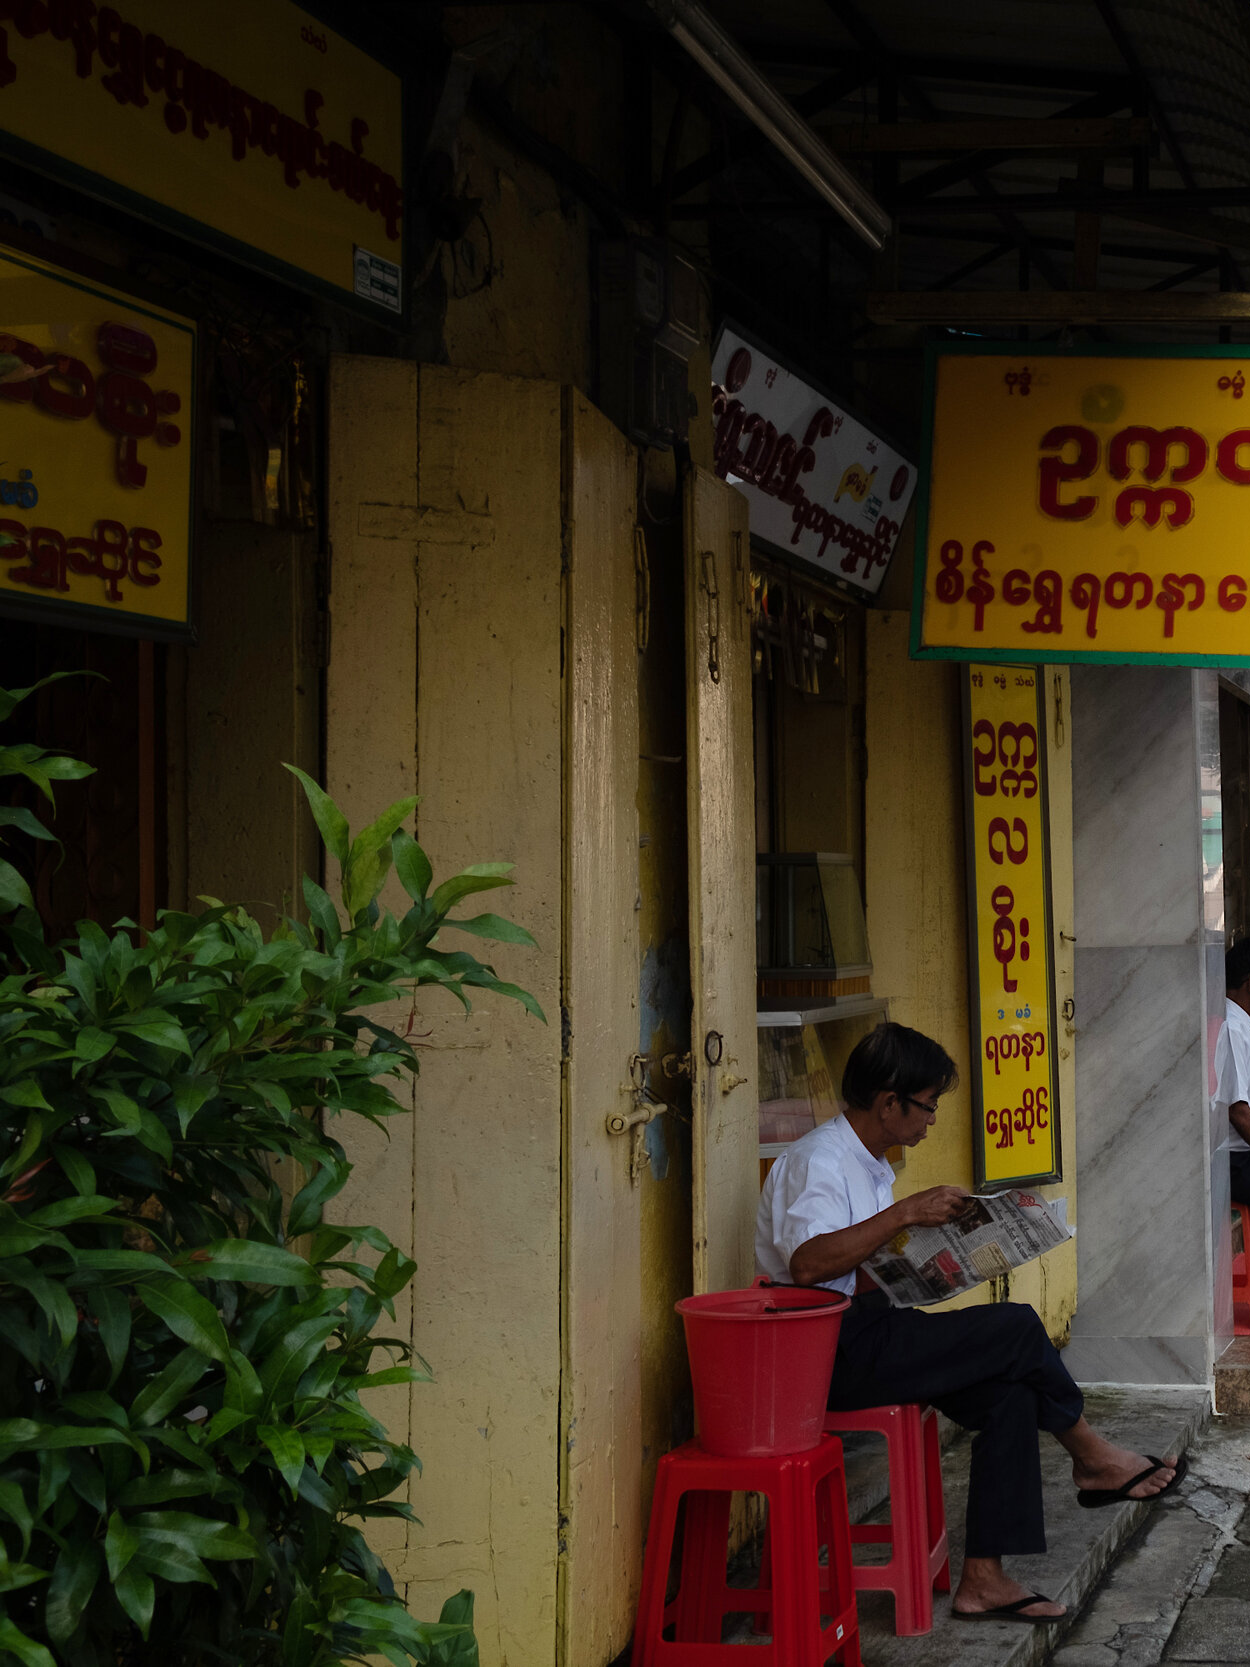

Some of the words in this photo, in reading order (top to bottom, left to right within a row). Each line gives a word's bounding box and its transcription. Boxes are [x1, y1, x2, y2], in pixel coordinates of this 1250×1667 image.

[1216, 370, 1246, 399] ဓမ္မံ
[985, 1031, 1045, 1075] ရတနာ
[985, 1086, 1049, 1149] ရွှေဆိုင်
